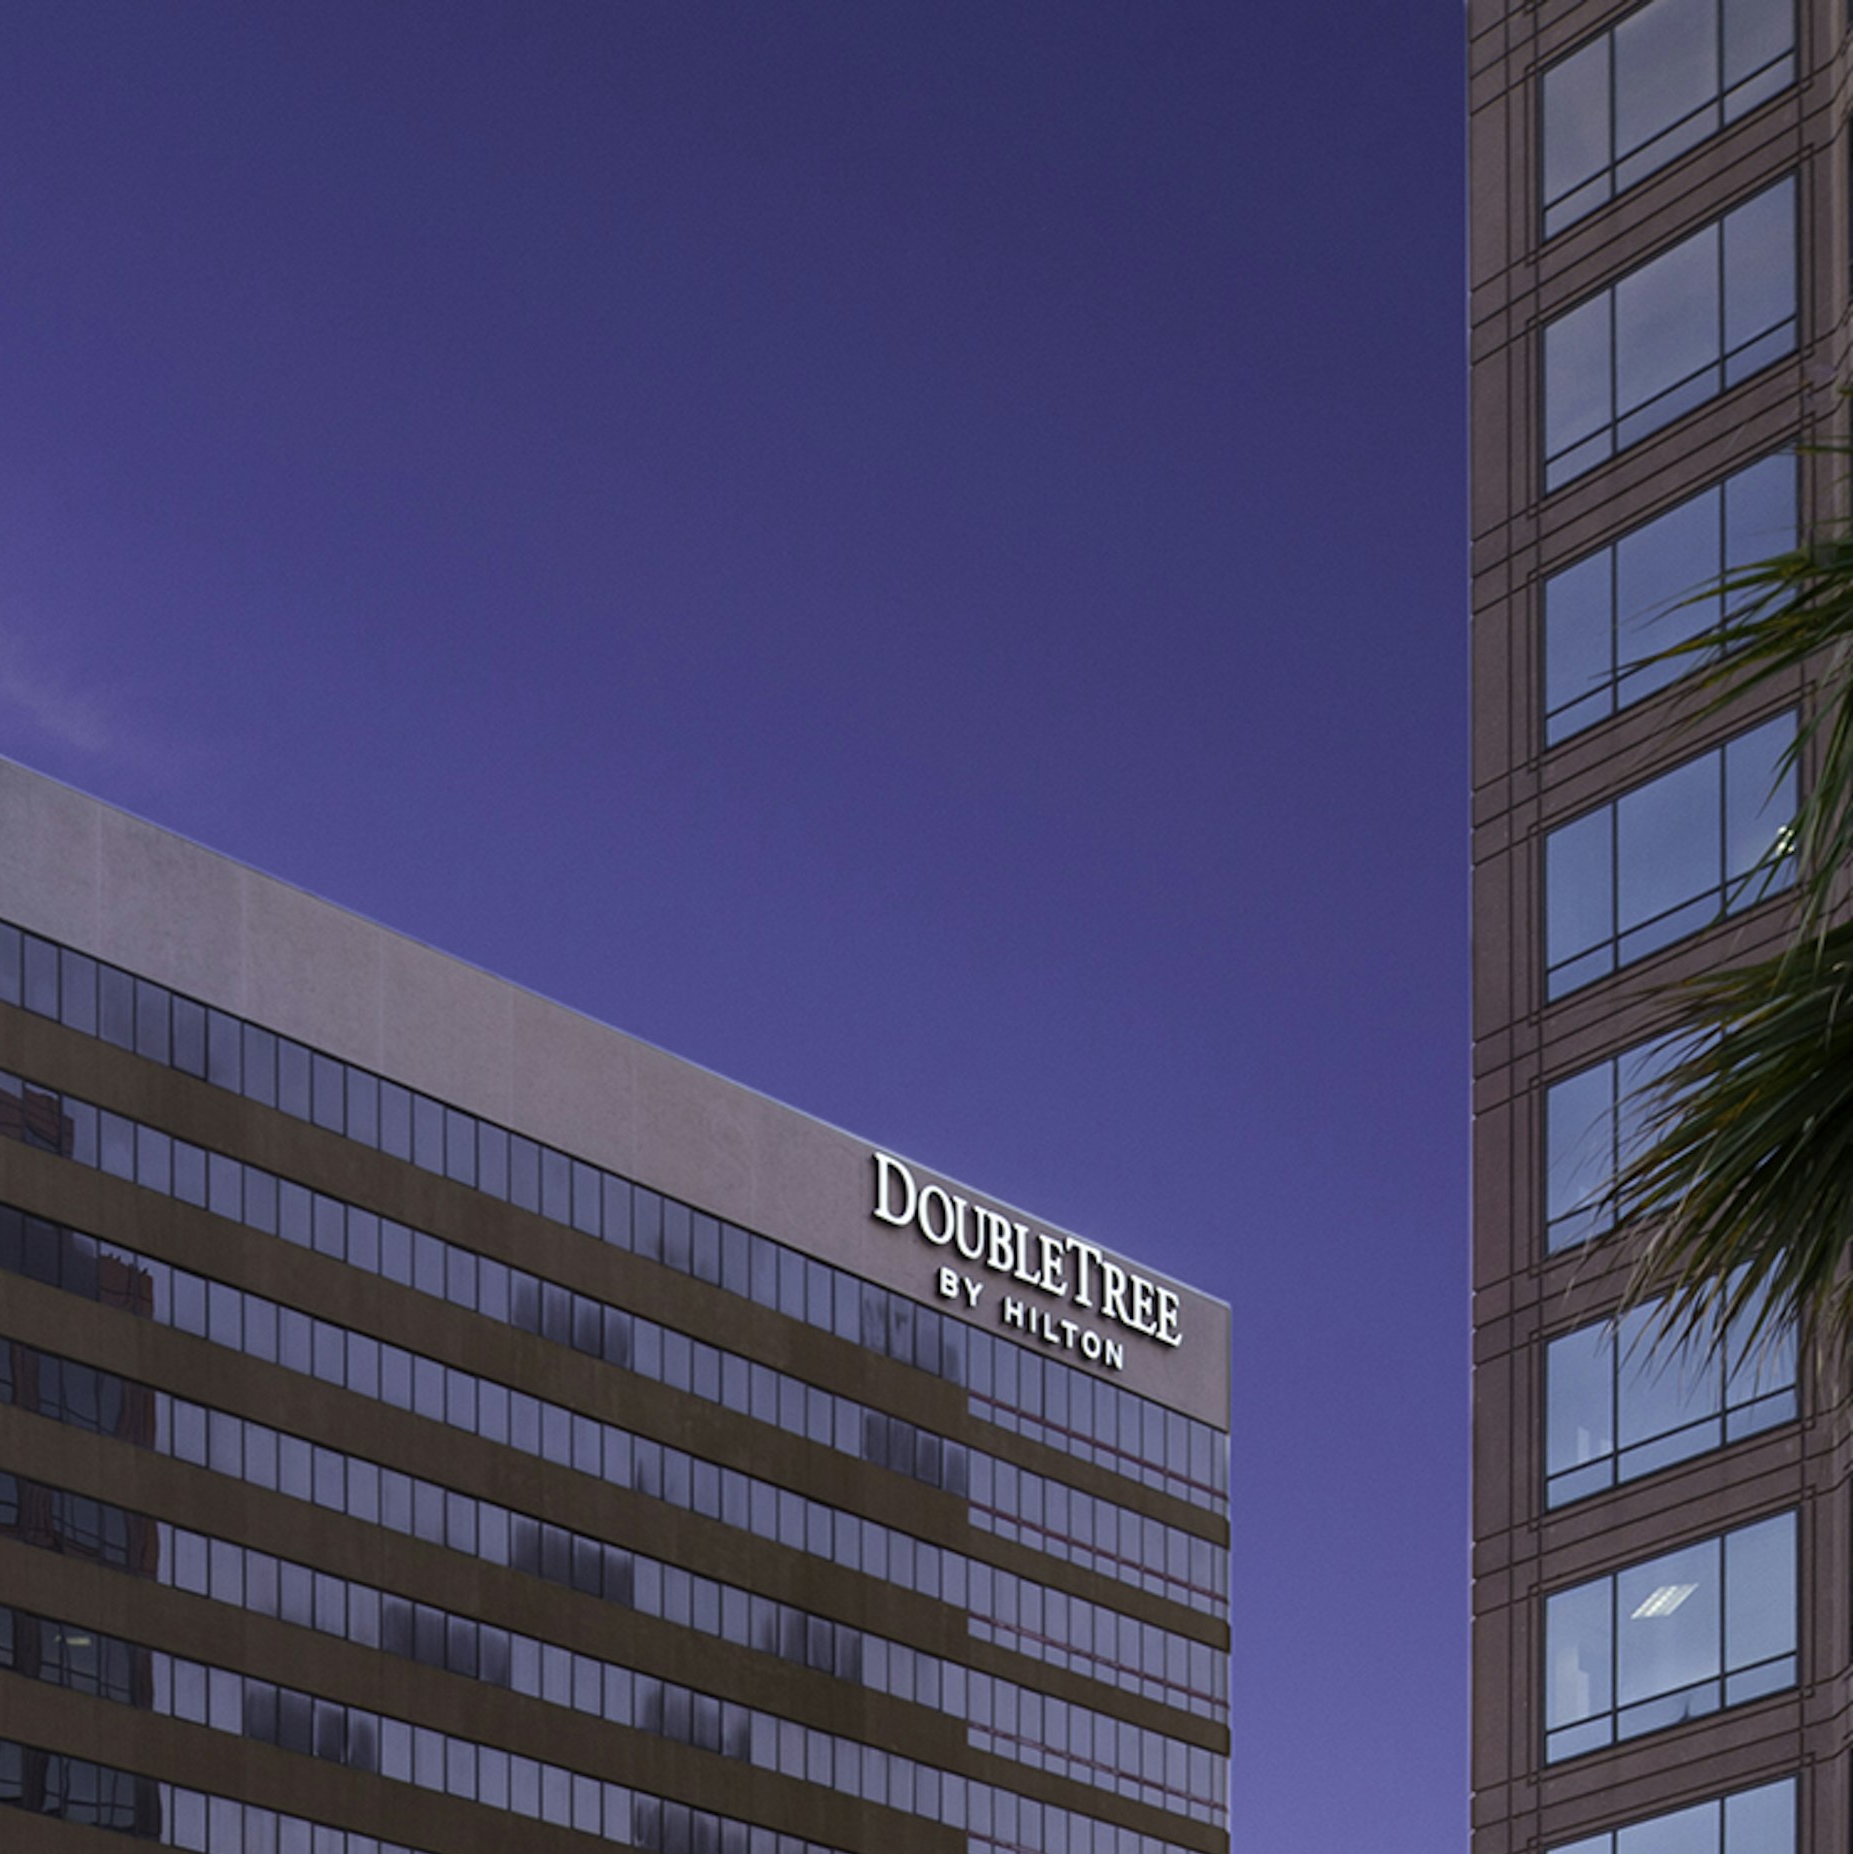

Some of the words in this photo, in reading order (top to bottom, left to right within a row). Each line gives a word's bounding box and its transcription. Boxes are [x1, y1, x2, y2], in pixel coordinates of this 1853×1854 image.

[873, 1152, 1183, 1347] DOUBLETREE
[939, 1266, 983, 1307] BY
[1004, 1297, 1123, 1370] HILTON
